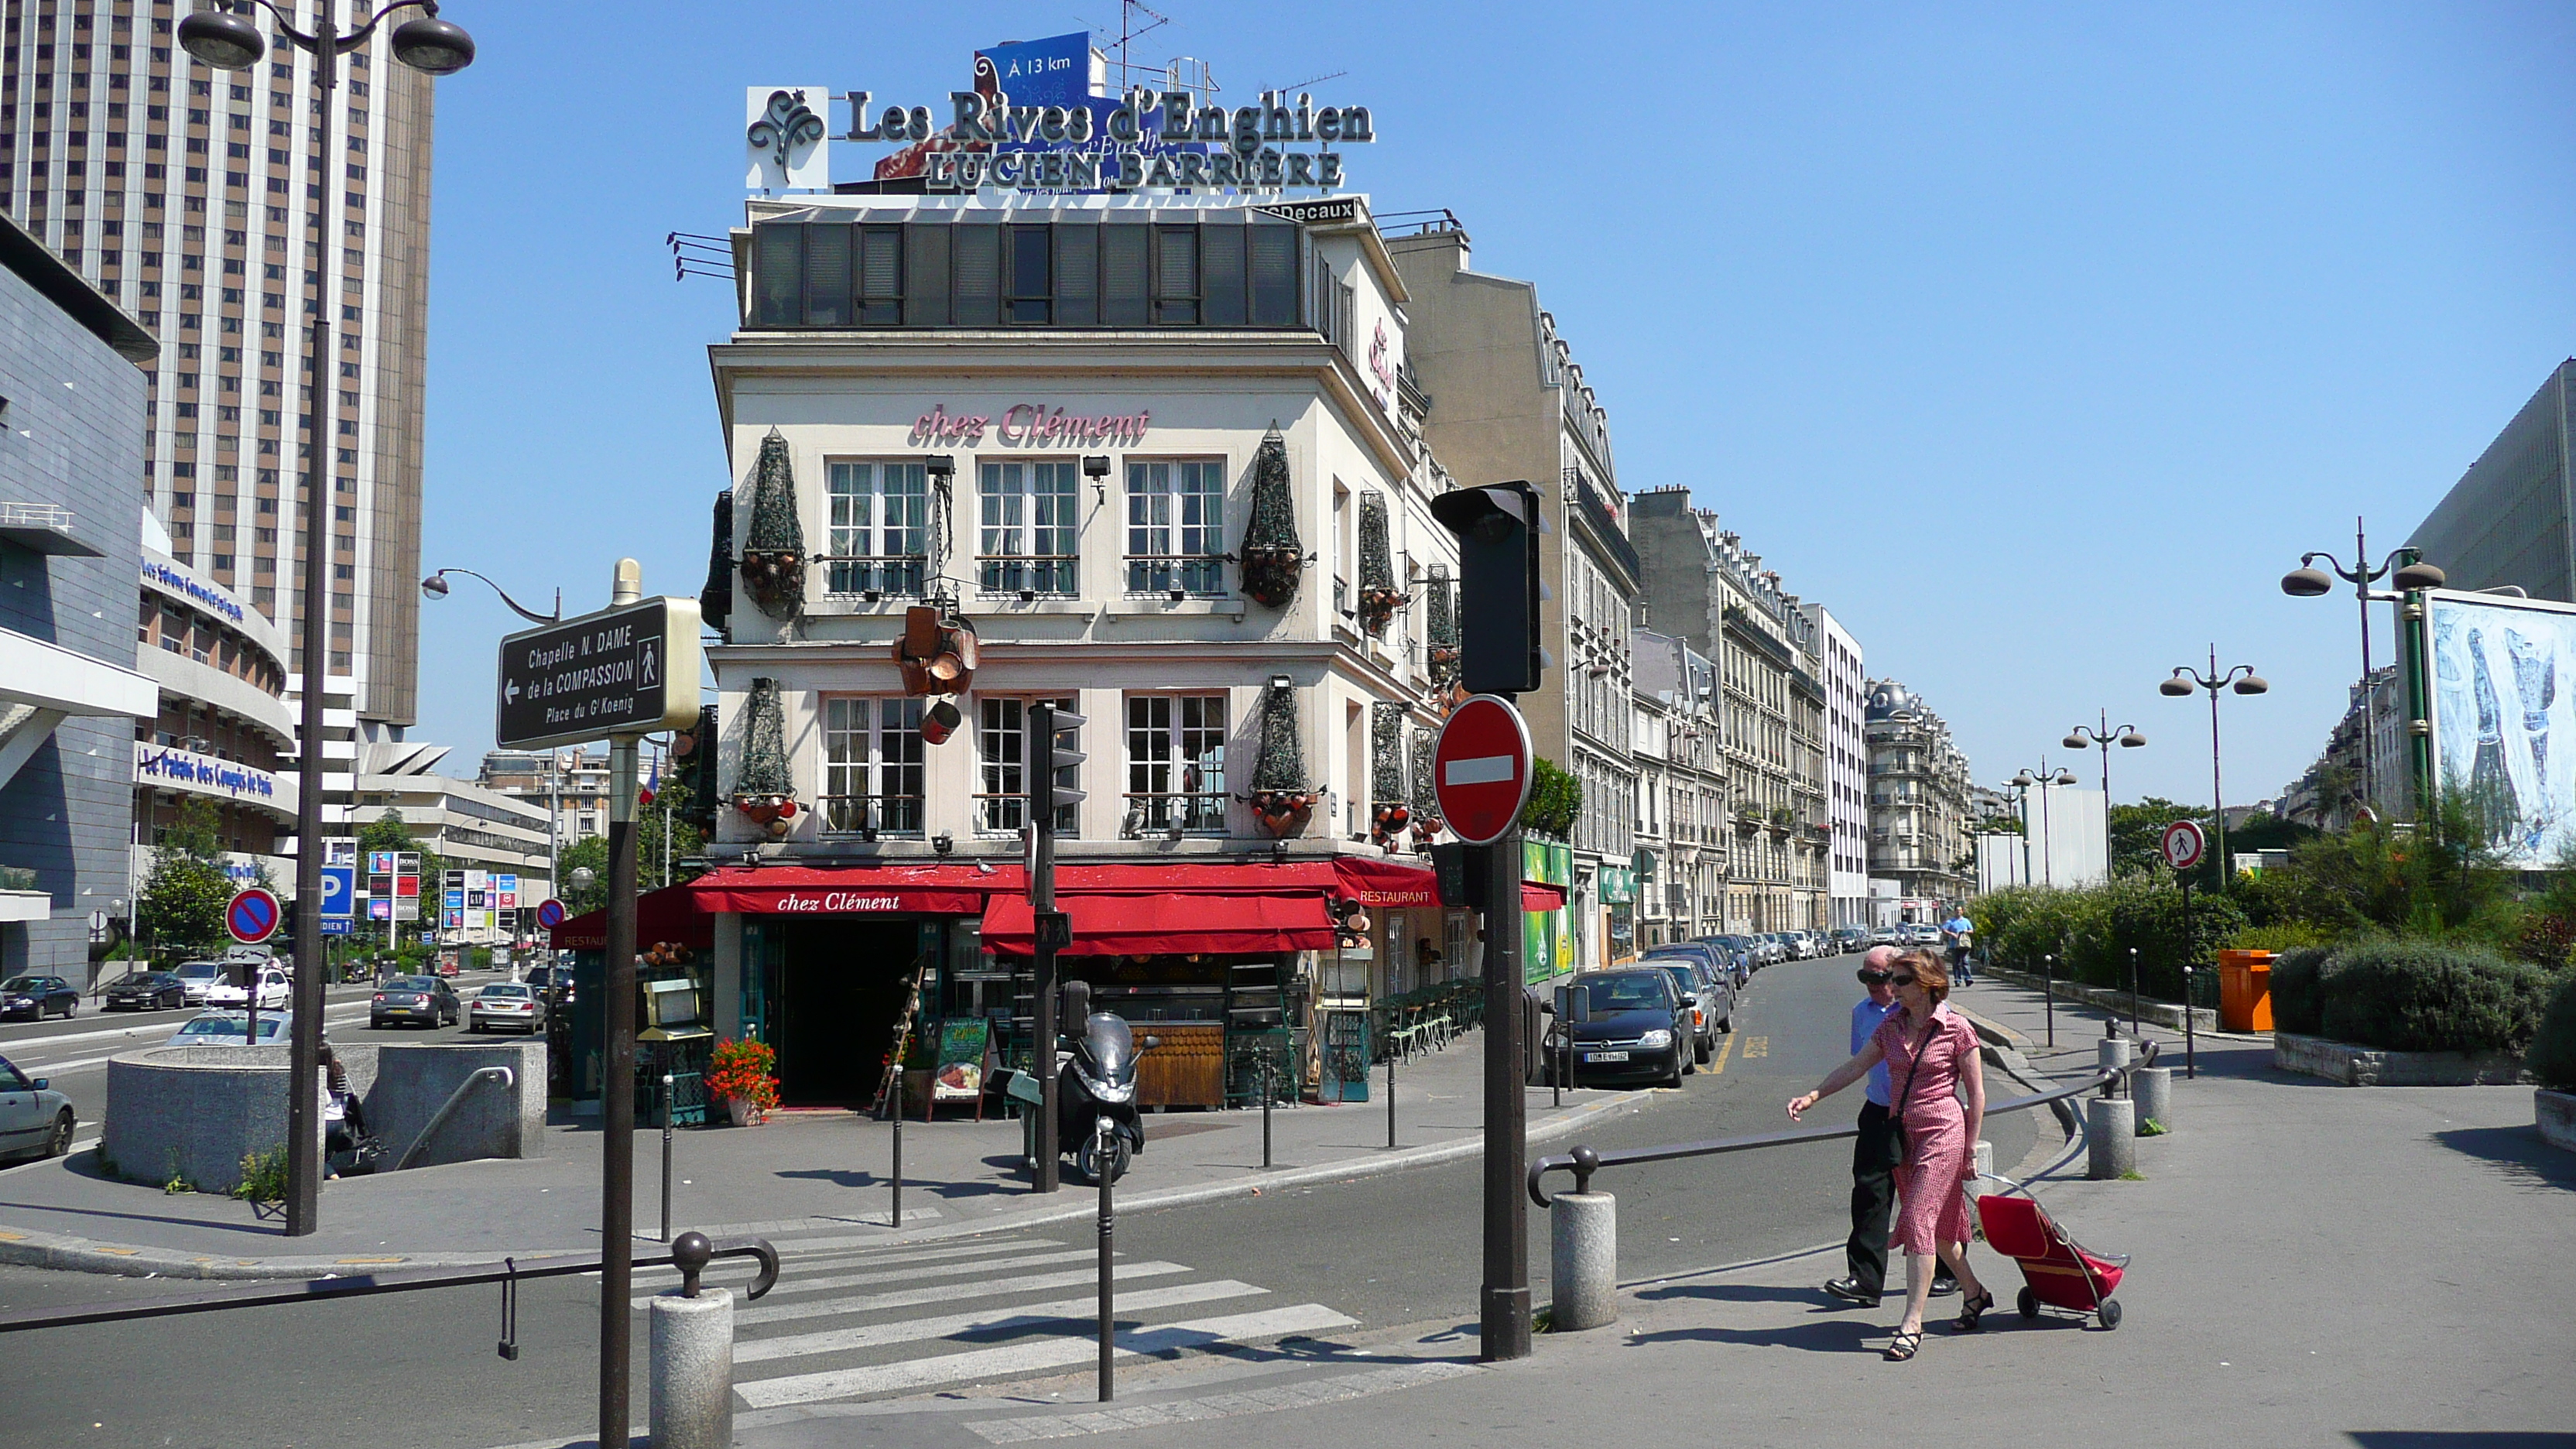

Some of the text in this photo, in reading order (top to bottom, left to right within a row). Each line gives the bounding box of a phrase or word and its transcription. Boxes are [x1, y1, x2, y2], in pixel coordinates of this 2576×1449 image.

[1009, 57, 1070, 77] À 13 km
[846, 91, 933, 142] Les
[949, 91, 1093, 143] Rives
[1107, 89, 1376, 155] d'Enghien
[927, 151, 1104, 189] LUCIEN
[1116, 146, 1346, 189] BARRIÈRE
[913, 403, 1153, 439] chez Clément
[529, 625, 632, 670] Chapelle N. DAME
[528, 659, 633, 699] de la COMPASSION
[546, 707, 570, 724] Place
[574, 703, 585, 718] du
[601, 693, 633, 714] Koenig
[197, 758, 214, 786] des
[320, 875, 341, 906] P
[470, 894, 484, 904] GAP
[777, 892, 899, 911] chez Clément
[1360, 890, 1430, 903] RESTAURANT
[320, 922, 342, 930] DIEN
